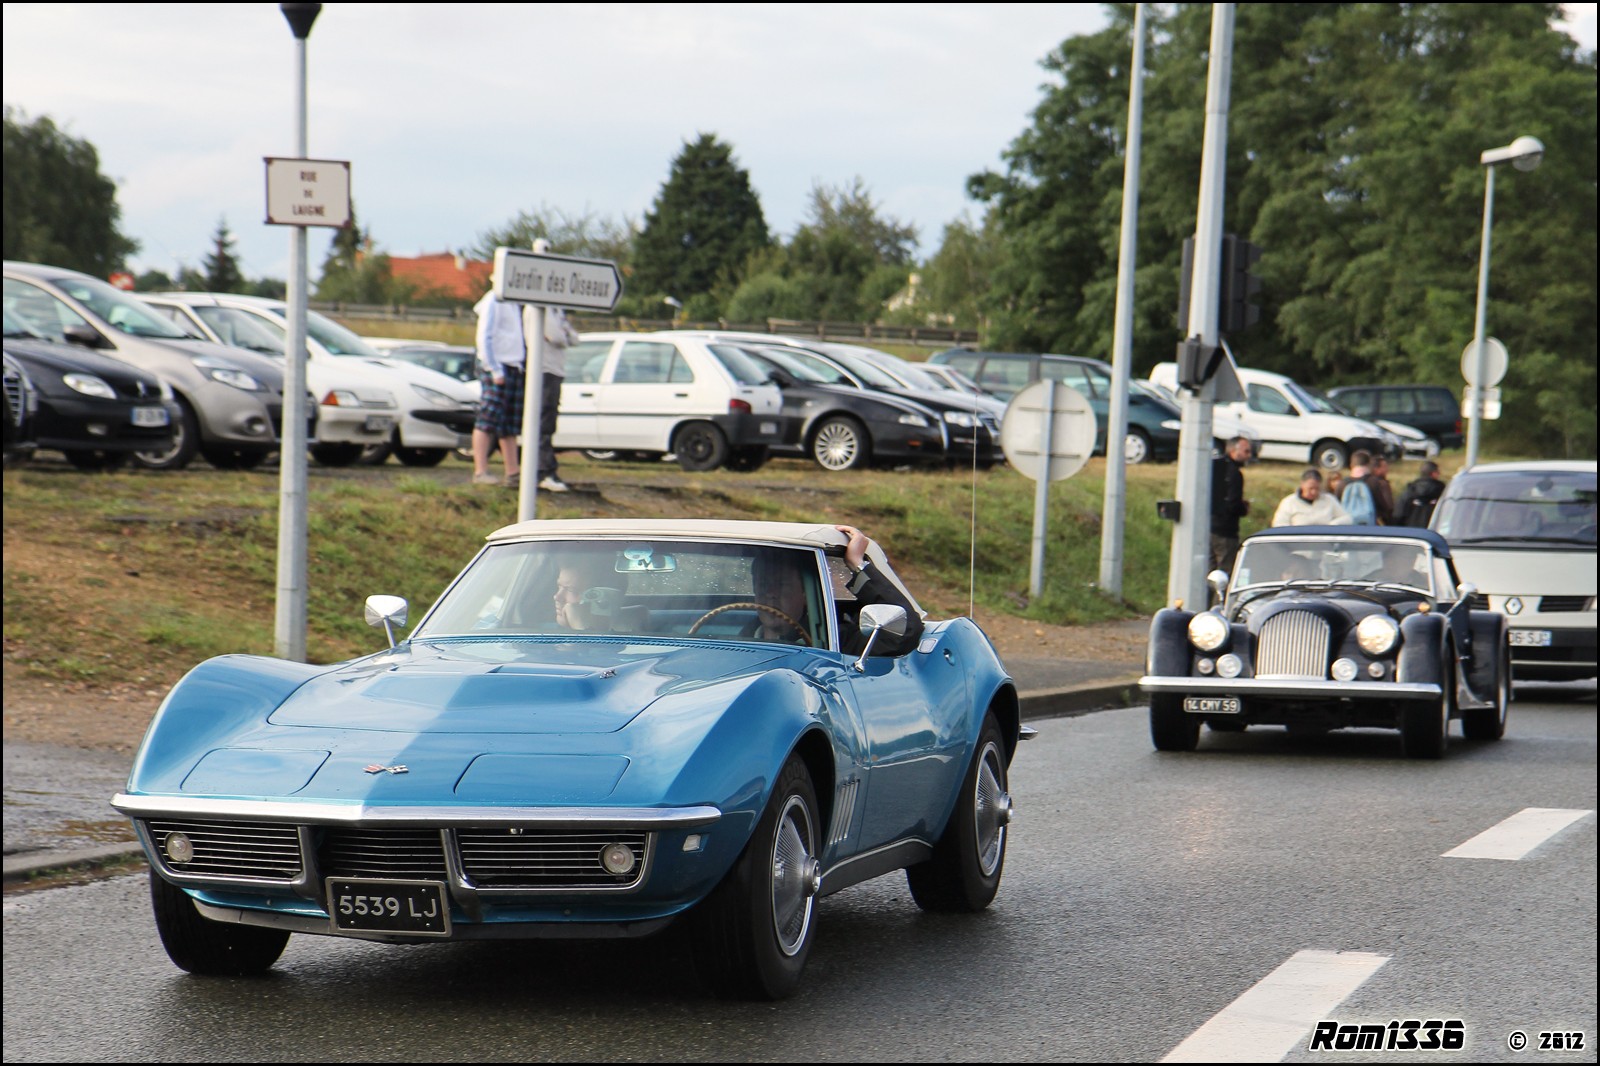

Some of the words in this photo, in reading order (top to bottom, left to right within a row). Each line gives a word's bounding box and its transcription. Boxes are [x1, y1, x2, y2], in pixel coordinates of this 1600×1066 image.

[300, 171, 317, 183] RUE
[507, 265, 542, 291] Jardin
[547, 270, 566, 293] des
[570, 271, 609, 298] Oiseaux
[1200, 699, 1221, 711] CMY
[1222, 699, 1237, 712] 59
[339, 895, 400, 917] 5539
[408, 897, 437, 918] LJ
